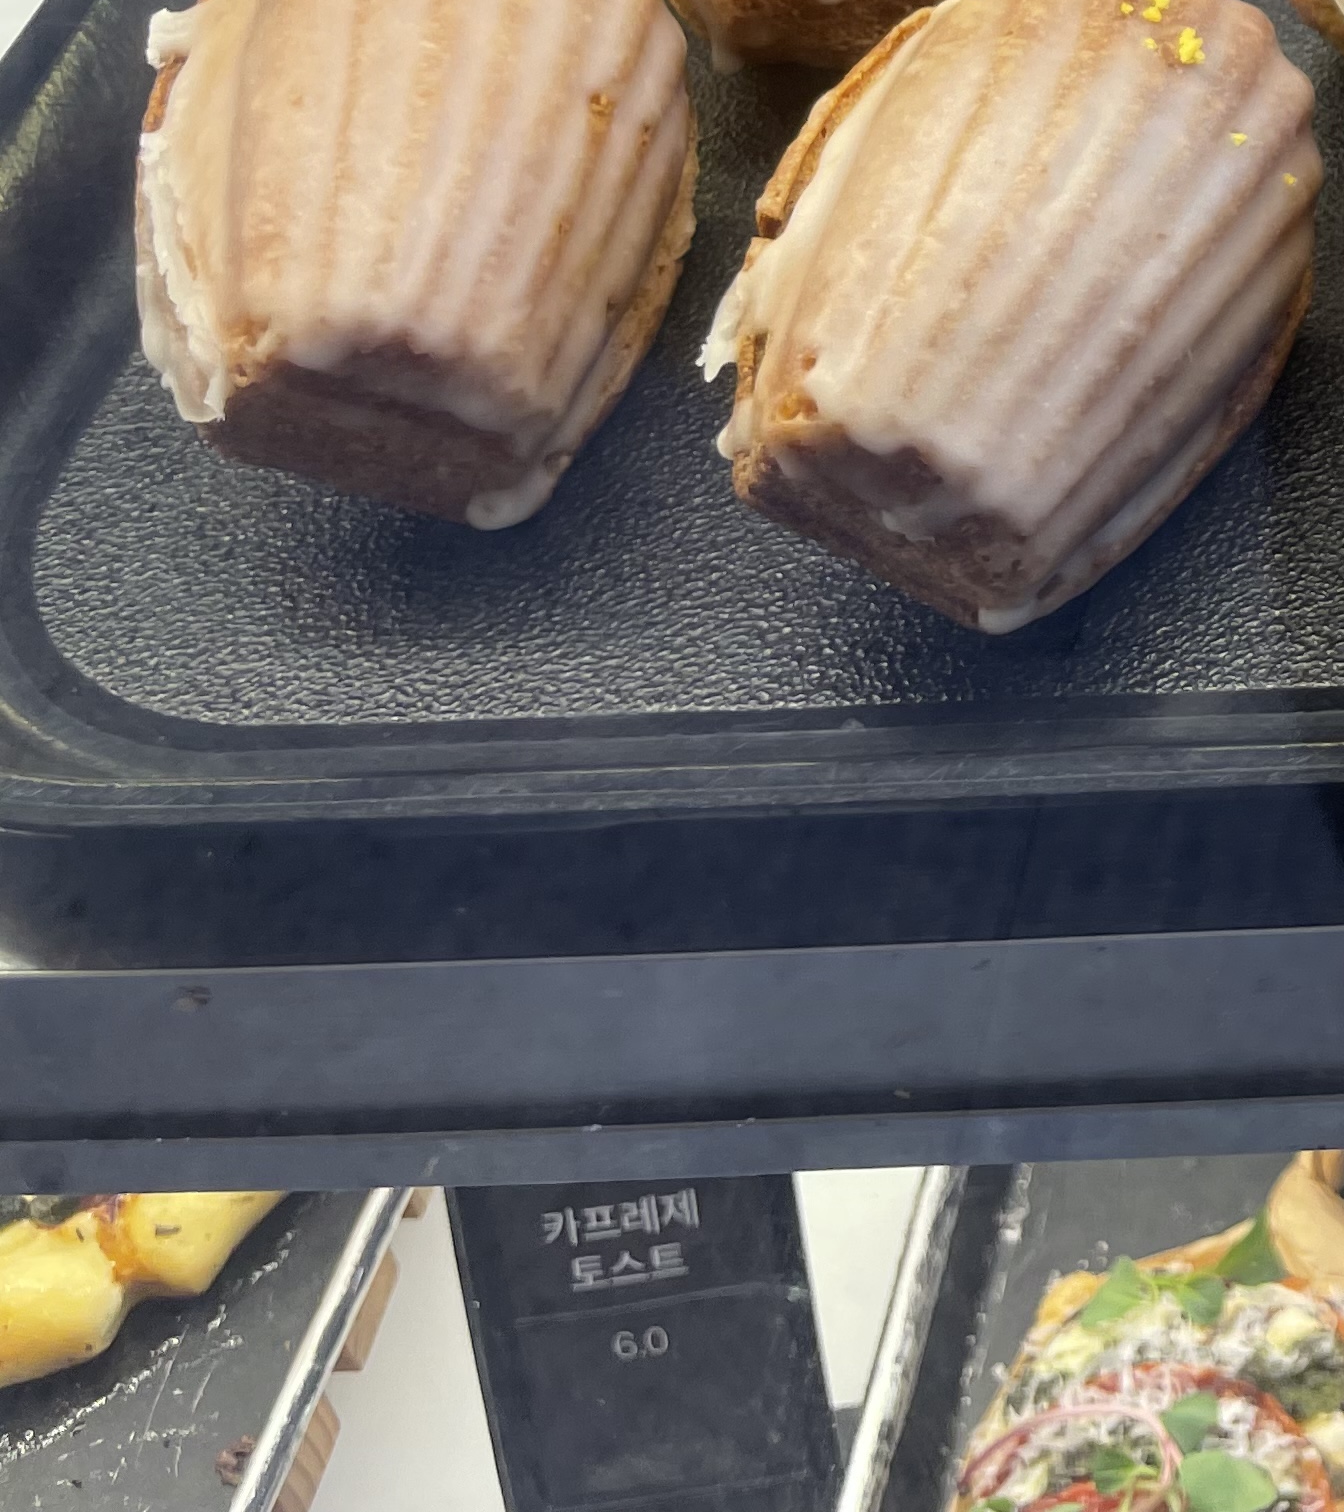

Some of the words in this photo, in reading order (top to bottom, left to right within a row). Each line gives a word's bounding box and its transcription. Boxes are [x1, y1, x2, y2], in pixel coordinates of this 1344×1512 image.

[541, 1188, 699, 1246] 카프레제
[571, 1242, 689, 1292] 토스트
[612, 1325, 669, 1360] 6.0
